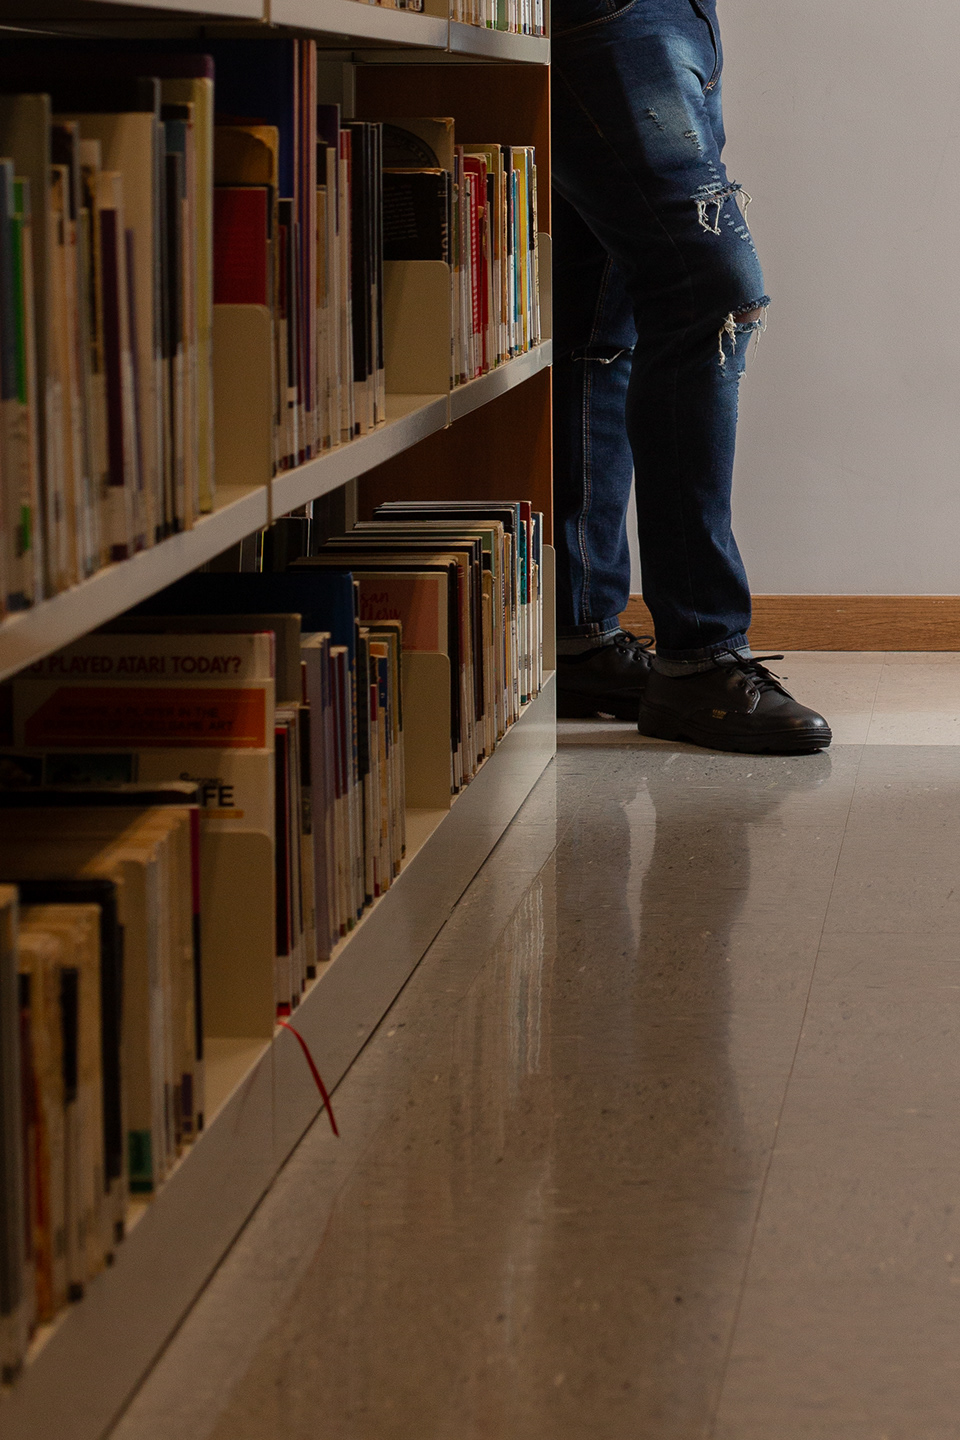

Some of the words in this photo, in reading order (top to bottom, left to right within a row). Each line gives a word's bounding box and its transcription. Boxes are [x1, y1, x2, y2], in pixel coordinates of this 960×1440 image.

[49, 656, 114, 673] PLAYED
[116, 656, 165, 673] ATARI
[171, 656, 241, 674] TODAY?
[196, 707, 219, 718] THE
[209, 721, 234, 732] ART
